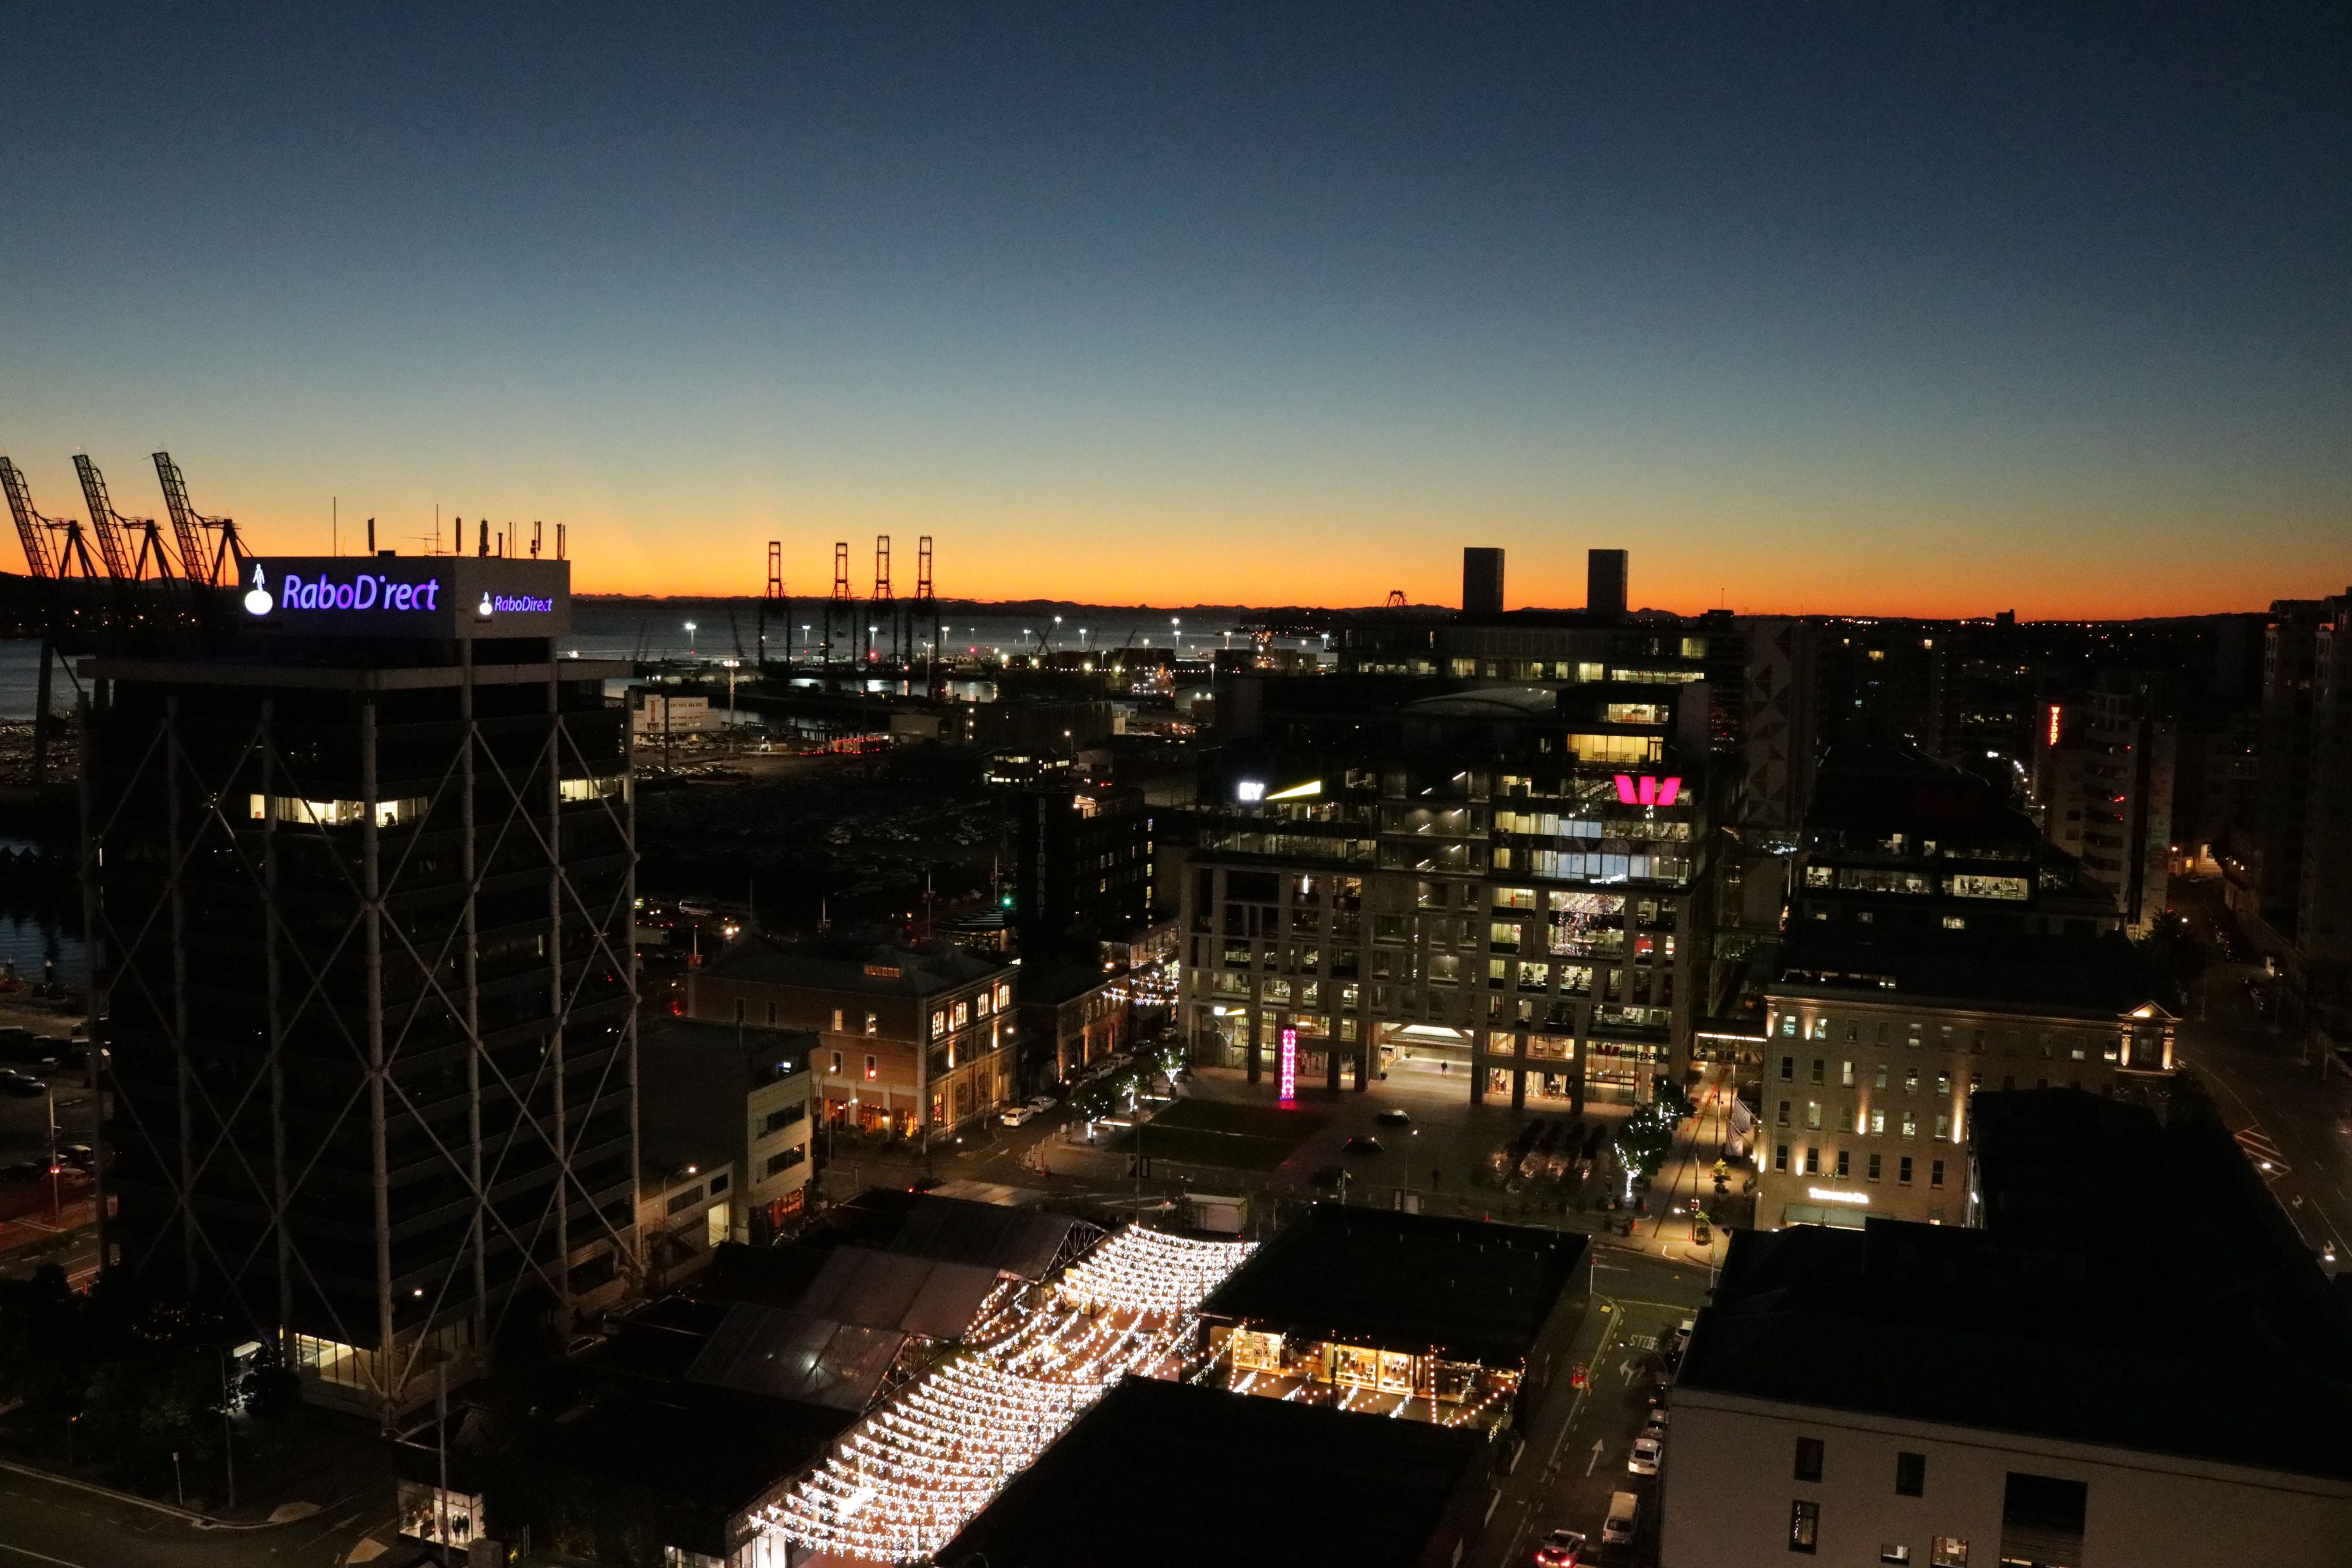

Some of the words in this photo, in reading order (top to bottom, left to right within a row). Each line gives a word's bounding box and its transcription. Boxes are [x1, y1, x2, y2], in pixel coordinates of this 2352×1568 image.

[494, 595, 552, 612] RaboDirect
[1036, 797, 1046, 921] BRITOMART
[1596, 1043, 1669, 1063] Westpa
